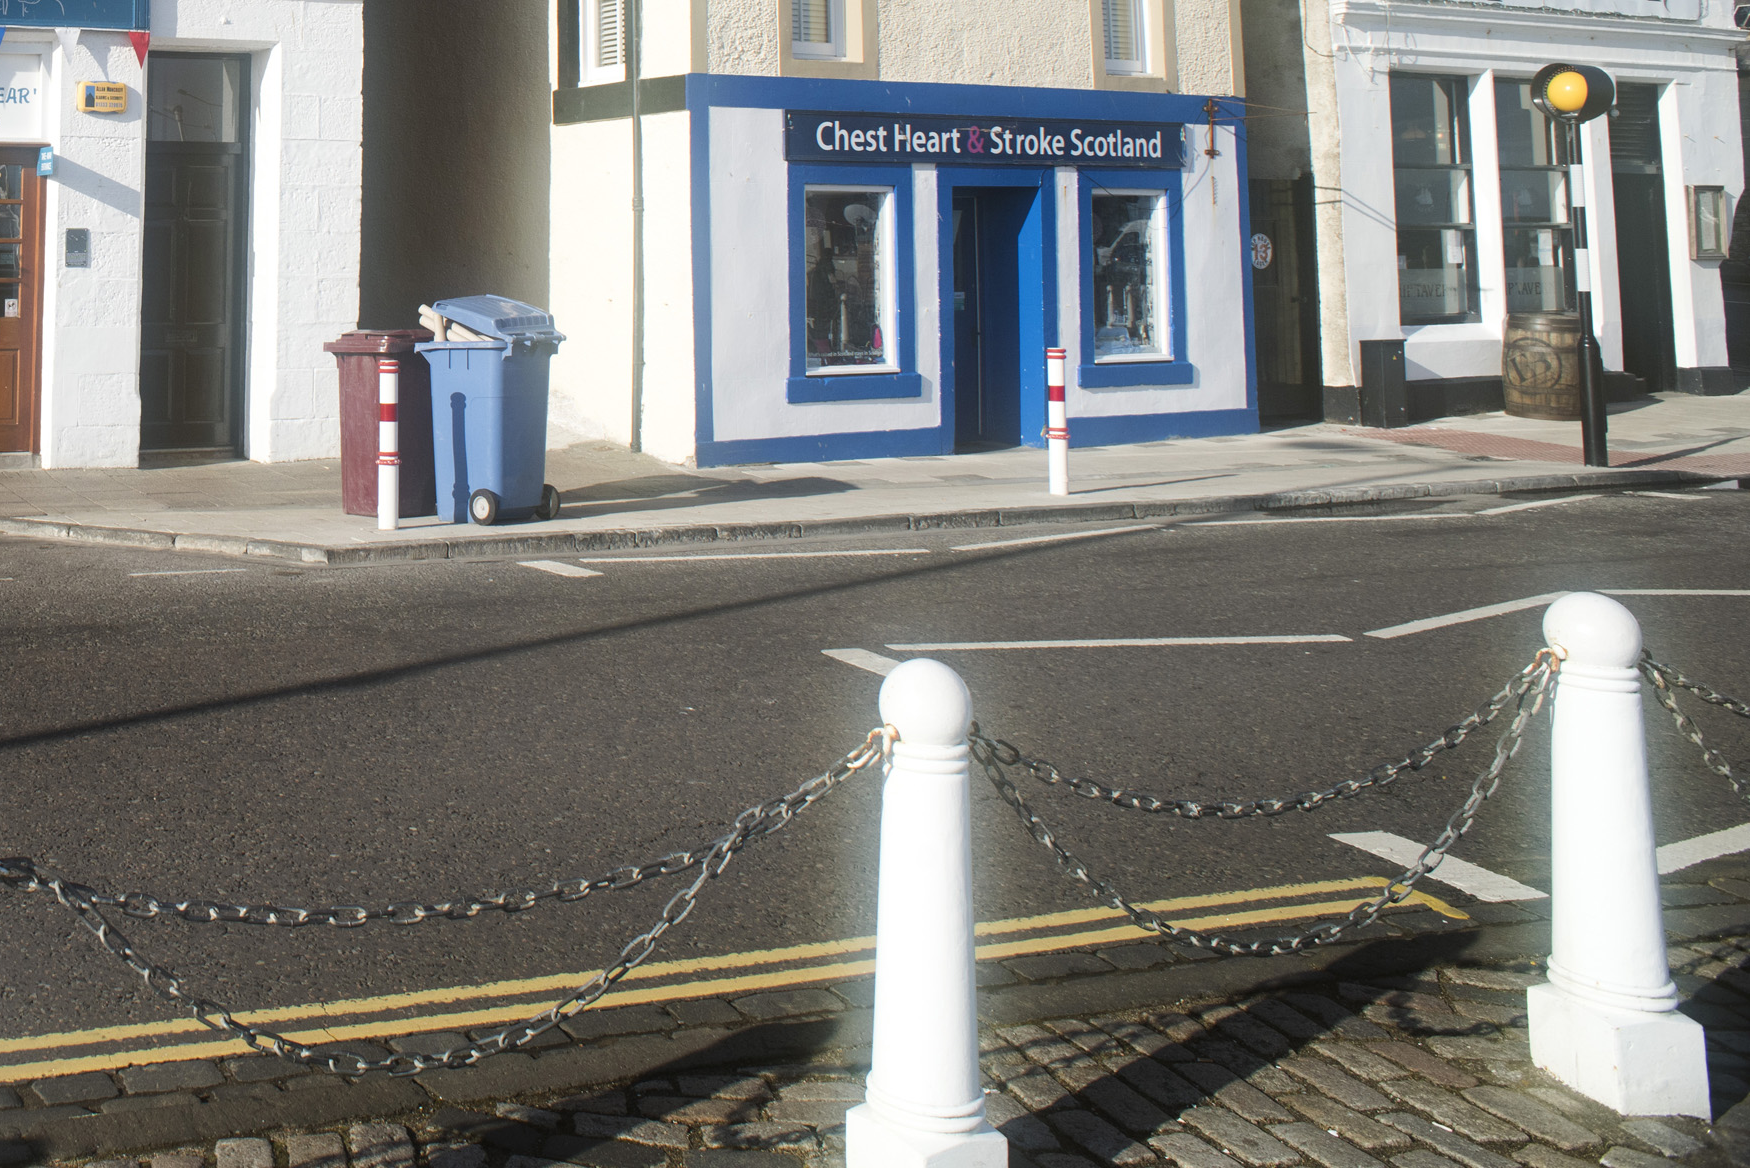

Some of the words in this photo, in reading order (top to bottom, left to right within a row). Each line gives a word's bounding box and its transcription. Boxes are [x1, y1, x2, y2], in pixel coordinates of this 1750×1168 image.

[816, 121, 887, 152] Chest
[893, 124, 961, 154] Heart
[966, 125, 985, 154] &
[990, 126, 1066, 157] Stroke
[1070, 129, 1162, 158] Scotland
[1253, 243, 1269, 261] 13
